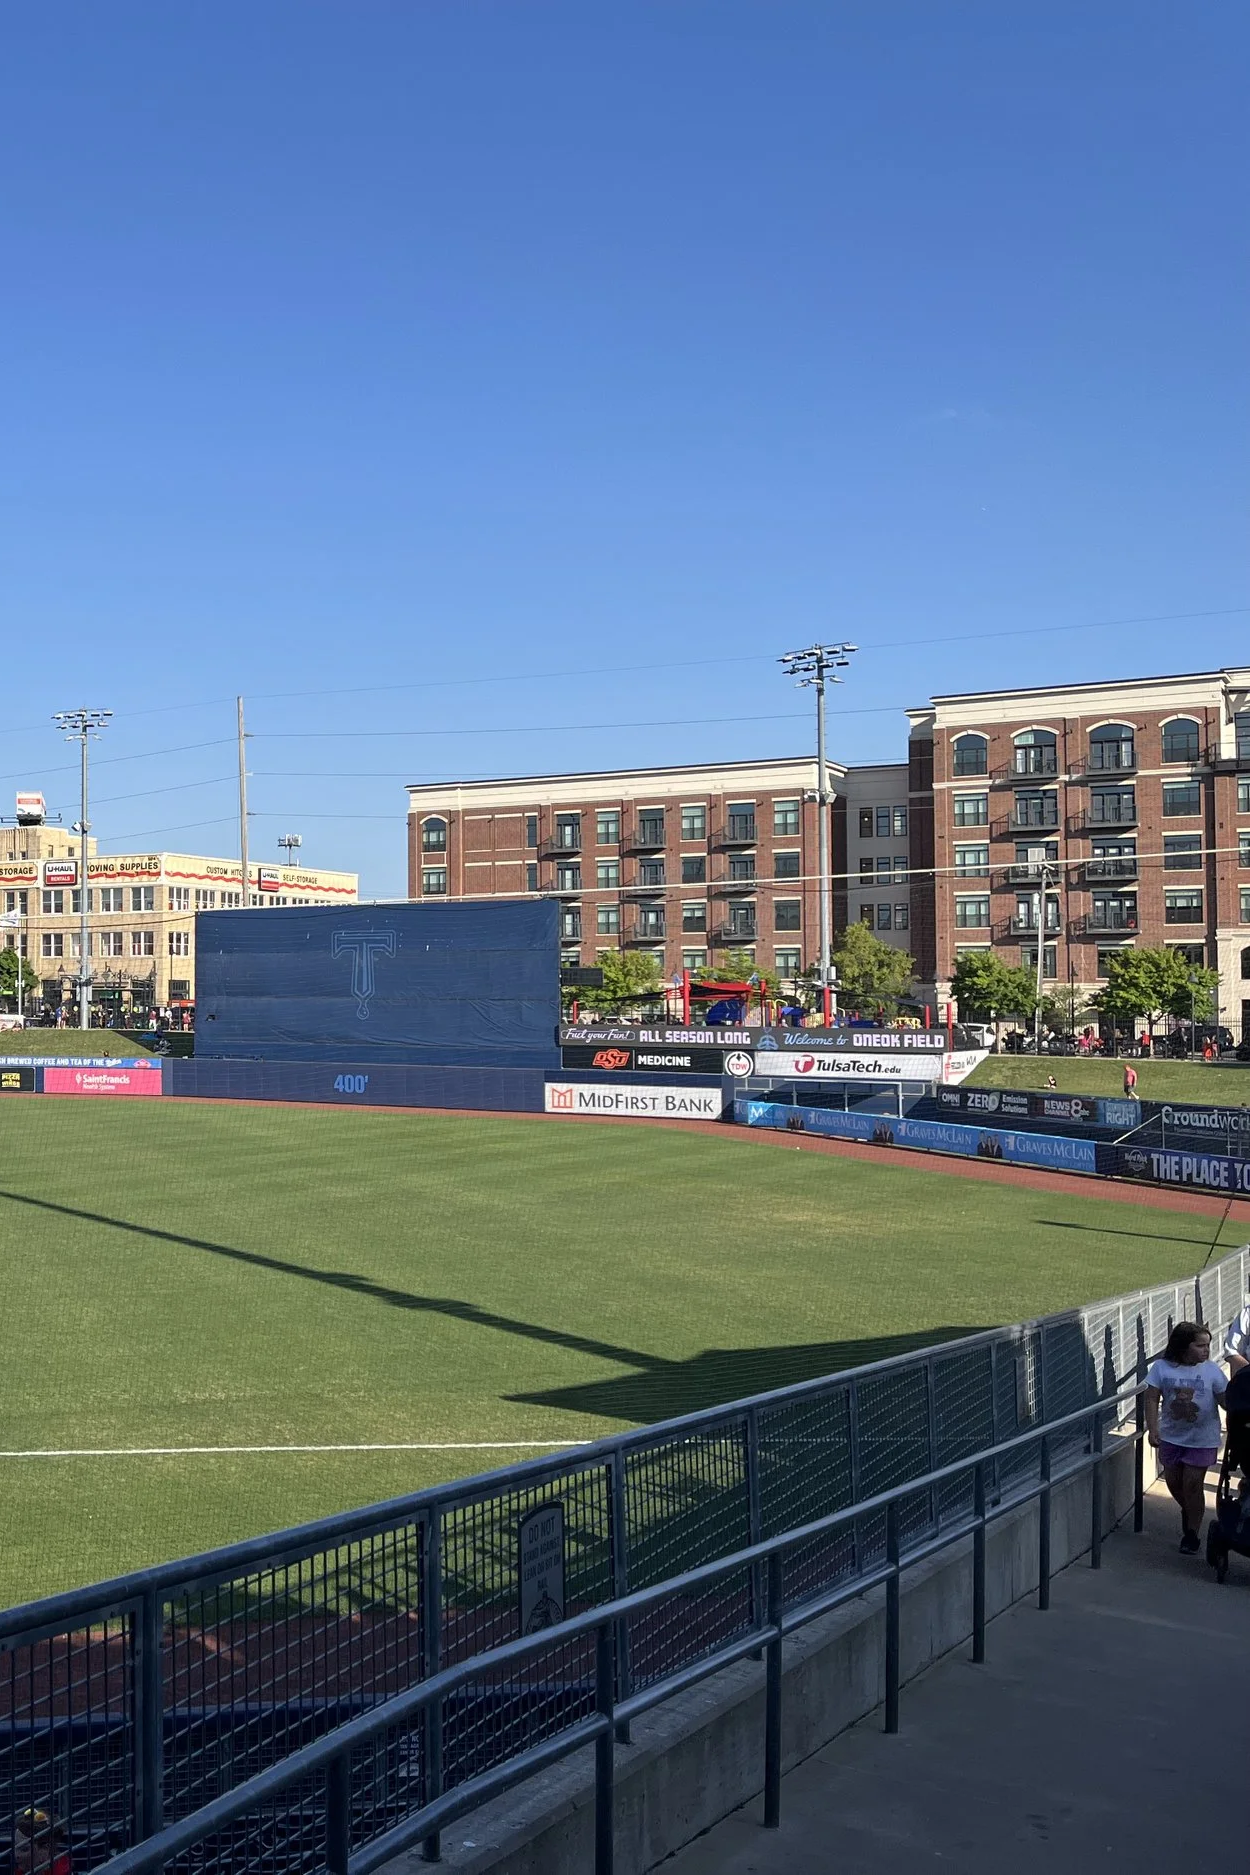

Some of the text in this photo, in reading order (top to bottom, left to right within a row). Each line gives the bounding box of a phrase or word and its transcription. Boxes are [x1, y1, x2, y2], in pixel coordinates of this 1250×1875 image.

[119, 862, 158, 871] SUPPLIES
[206, 866, 228, 876] CUSTOM
[282, 875, 318, 885] SELF-STORAGE
[565, 1028, 750, 1045] Fuel your Fun! ALL SEASON LONG
[783, 1033, 944, 1048] Welcome to ONEOK FIELD
[7, 1058, 32, 1066] BREWED
[33, 1058, 55, 1066] COFFEE
[56, 1058, 69, 1066] AND
[71, 1058, 82, 1066] TEA
[83, 1058, 91, 1066] OF
[592, 1049, 691, 1069] OSU MEDICINE
[816, 1059, 901, 1074] TulsaTech.edu
[333, 1074, 369, 1095] 400'
[579, 1092, 714, 1112] MIDFIRST BANK
[942, 1092, 1000, 1111] OMNI ZERO
[1002, 1094, 1028, 1104] Emission
[1001, 1104, 1029, 1114] Solutions
[1044, 1099, 1082, 1117] NEWS 8
[1106, 1112, 1135, 1125] RIGHT
[1150, 1153, 1180, 1181] THE
[1182, 1156, 1229, 1188] PLACE
[528, 1516, 555, 1544] DO NOT
[524, 1564, 537, 1582] LEAN
